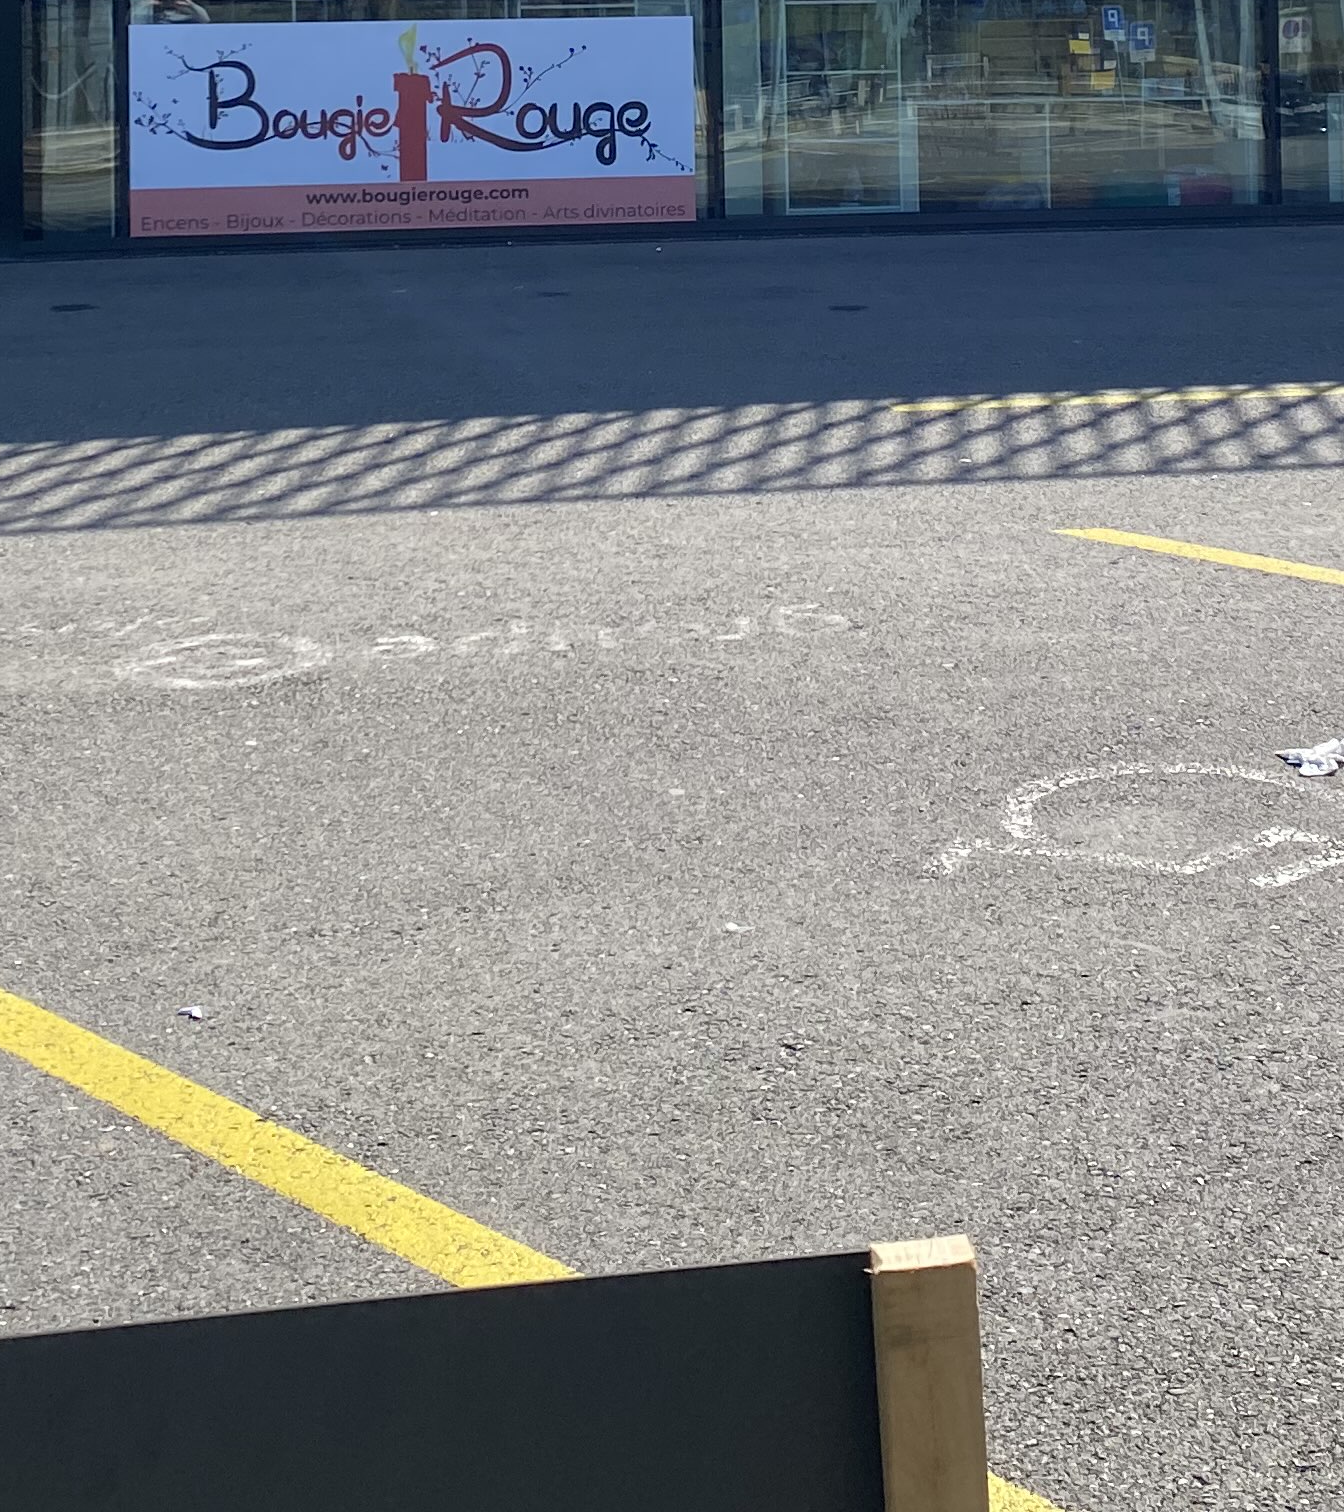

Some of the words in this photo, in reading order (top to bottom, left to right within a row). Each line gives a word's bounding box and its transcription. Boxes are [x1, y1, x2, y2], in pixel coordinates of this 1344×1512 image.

[182, 60, 394, 161] Bougie
[429, 42, 652, 166] Rouge
[306, 186, 530, 206] www.bougierouge.com
[140, 216, 209, 231] Encens
[226, 214, 284, 232] Bijoux
[301, 209, 412, 226] Décorations
[429, 206, 526, 223] Méditation
[543, 205, 579, 221] Arts
[583, 201, 686, 219] divinatoires
